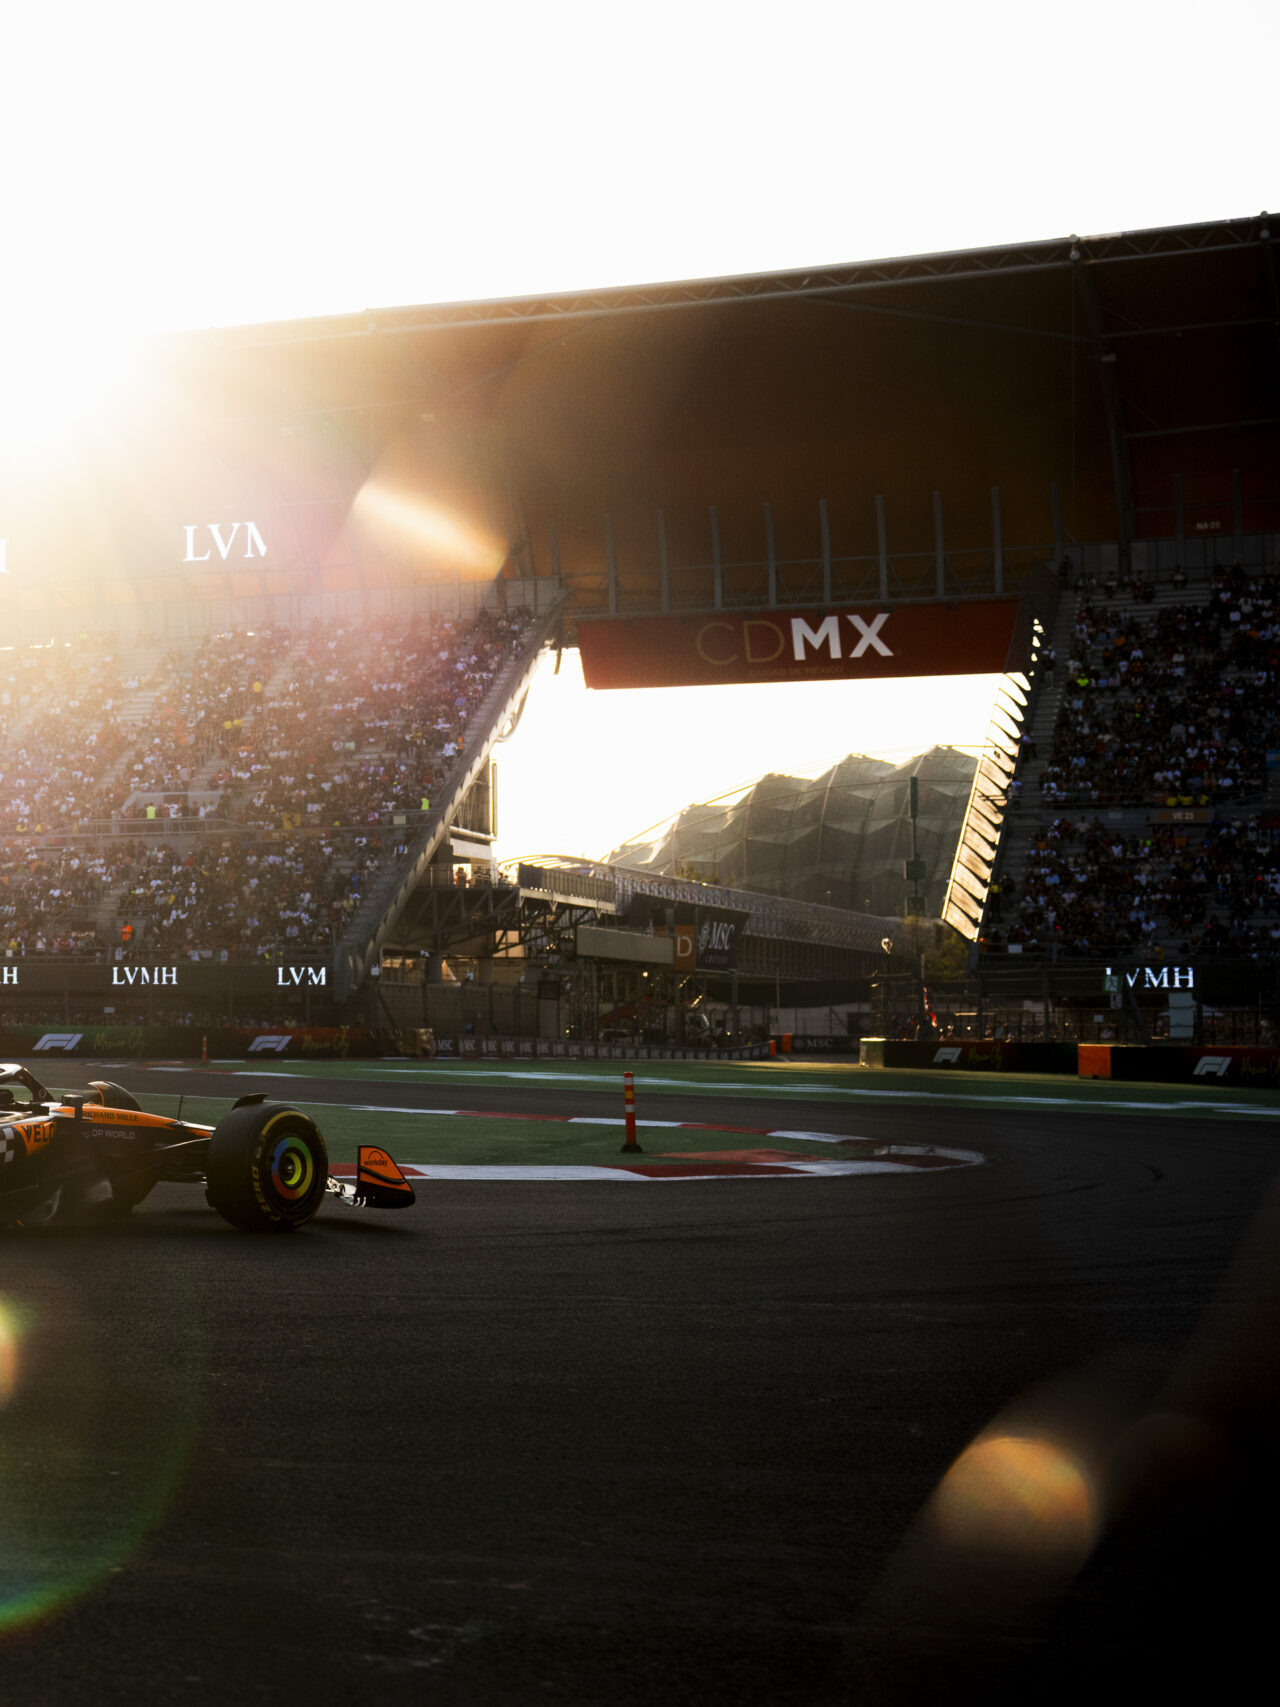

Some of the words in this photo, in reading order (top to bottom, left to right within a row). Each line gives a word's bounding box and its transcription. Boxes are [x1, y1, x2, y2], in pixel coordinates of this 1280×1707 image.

[696, 613, 895, 666] CDMX
[708, 920, 735, 951] MSC
[676, 936, 693, 957] D
[1104, 966, 1196, 990] VMH
[32, 1033, 84, 1052] F1
[247, 1036, 293, 1053] F1
[932, 1047, 963, 1063] F1
[1192, 1056, 1233, 1077] F1
